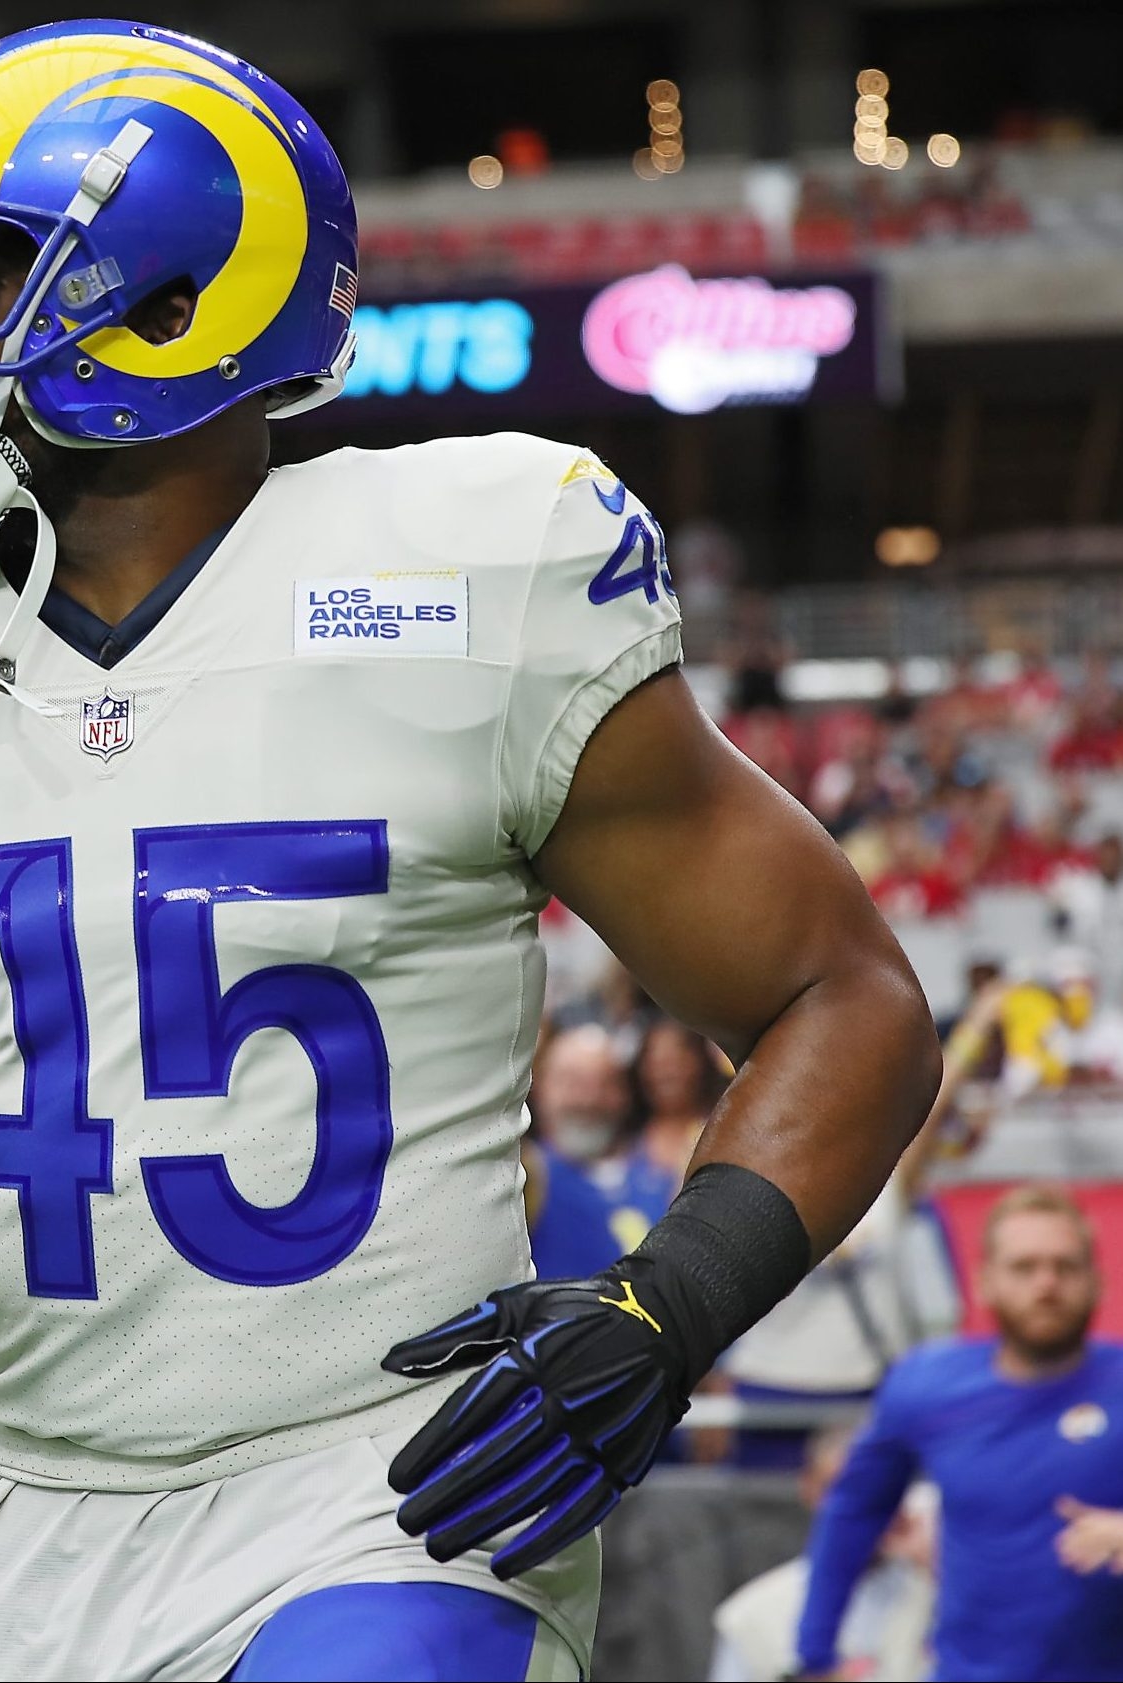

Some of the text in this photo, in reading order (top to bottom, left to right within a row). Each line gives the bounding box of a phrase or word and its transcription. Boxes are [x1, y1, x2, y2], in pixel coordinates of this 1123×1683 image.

[309, 588, 372, 606] LOS
[309, 605, 457, 623] ANGELES
[309, 622, 401, 640] RAMS
[88, 720, 125, 748] NFL
